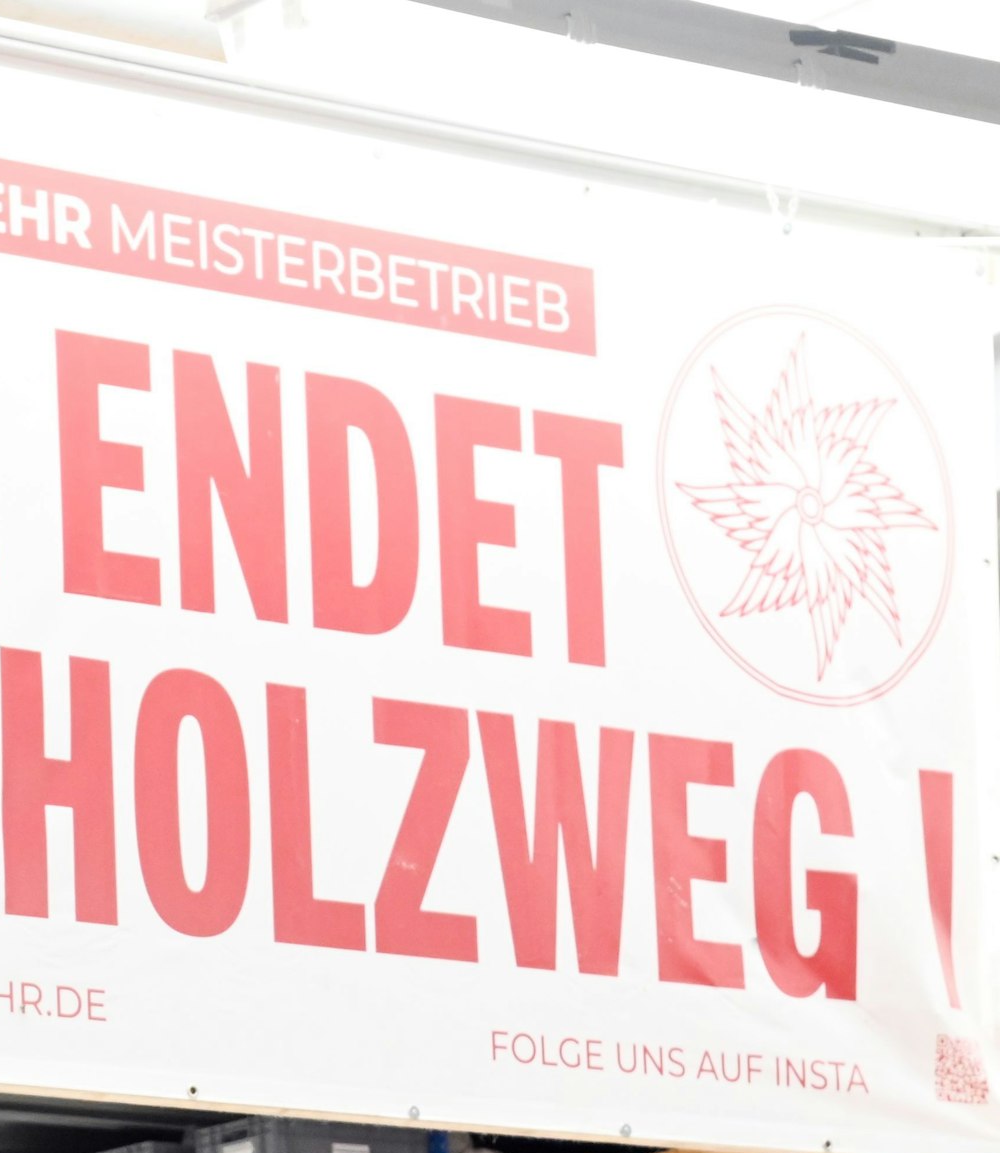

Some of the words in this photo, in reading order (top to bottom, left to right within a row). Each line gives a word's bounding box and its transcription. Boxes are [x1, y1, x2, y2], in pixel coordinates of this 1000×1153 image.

[110, 202, 572, 334] MEISTERBETRIEB
[54, 328, 625, 668] ENDET
[0, 645, 858, 1002] HOLZWEG
[490, 1030, 604, 1071] FOLGE
[616, 1042, 687, 1078] UNS
[696, 1050, 764, 1084] AUF
[775, 1056, 870, 1095] INSTA
